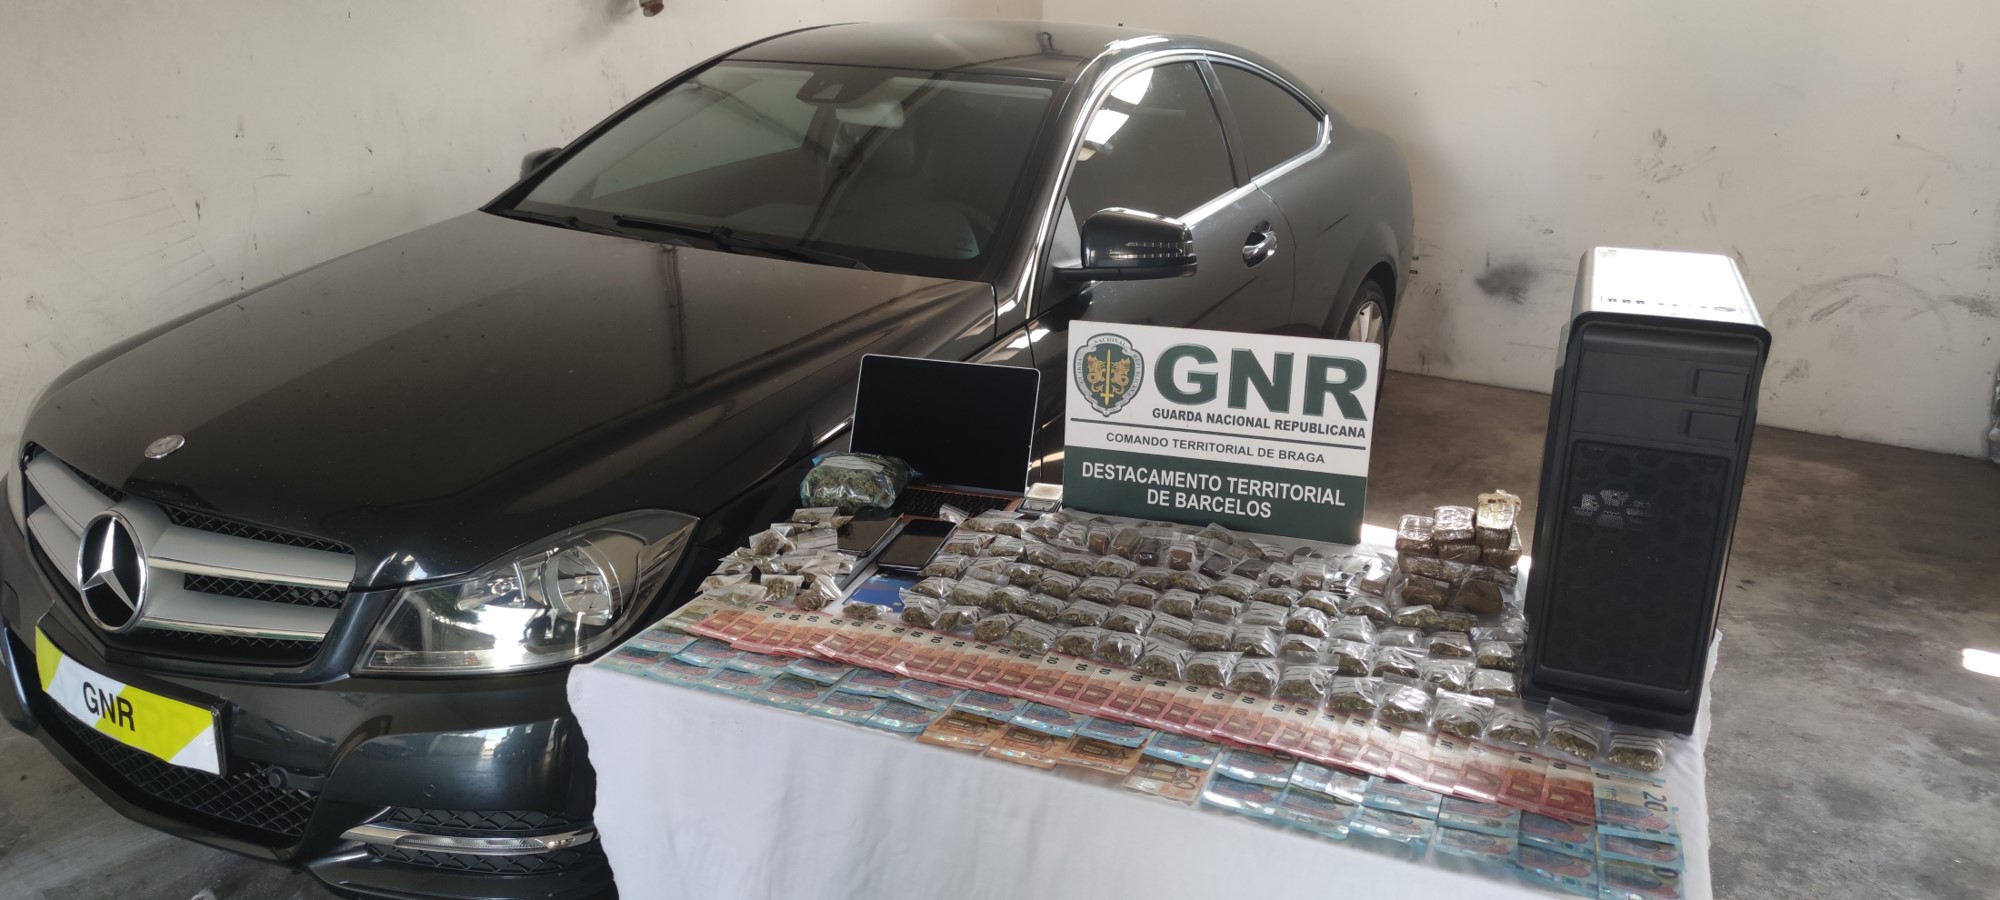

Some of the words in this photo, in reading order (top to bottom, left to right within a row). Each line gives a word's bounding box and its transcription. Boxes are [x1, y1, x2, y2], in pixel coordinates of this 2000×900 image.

[1093, 336, 1126, 347] NACIONAL
[1154, 342, 1368, 421] GNR
[1152, 407, 1202, 423] GUARDA
[1206, 412, 1270, 430] NACIONAL
[1274, 419, 1366, 439] REPUBLICANA
[1106, 432, 1169, 448] COMANDO
[1172, 438, 1254, 456] TERRITORIAL
[1257, 447, 1275, 459] DE
[1278, 450, 1325, 464] BRAGA
[1082, 461, 1222, 492] DESTACAMENTO
[1227, 476, 1346, 507] TERRITORIAL
[1147, 488, 1170, 506] DE
[1174, 491, 1272, 518] BARCELOS
[1046, 656, 1059, 665] 10
[1075, 663, 1088, 671] 10
[1211, 691, 1225, 699] 10
[1242, 696, 1255, 704] 10
[83, 681, 136, 731] GNR
[1272, 703, 1285, 712] 10
[1295, 707, 1308, 716] 10
[1642, 791, 1668, 812] 20
